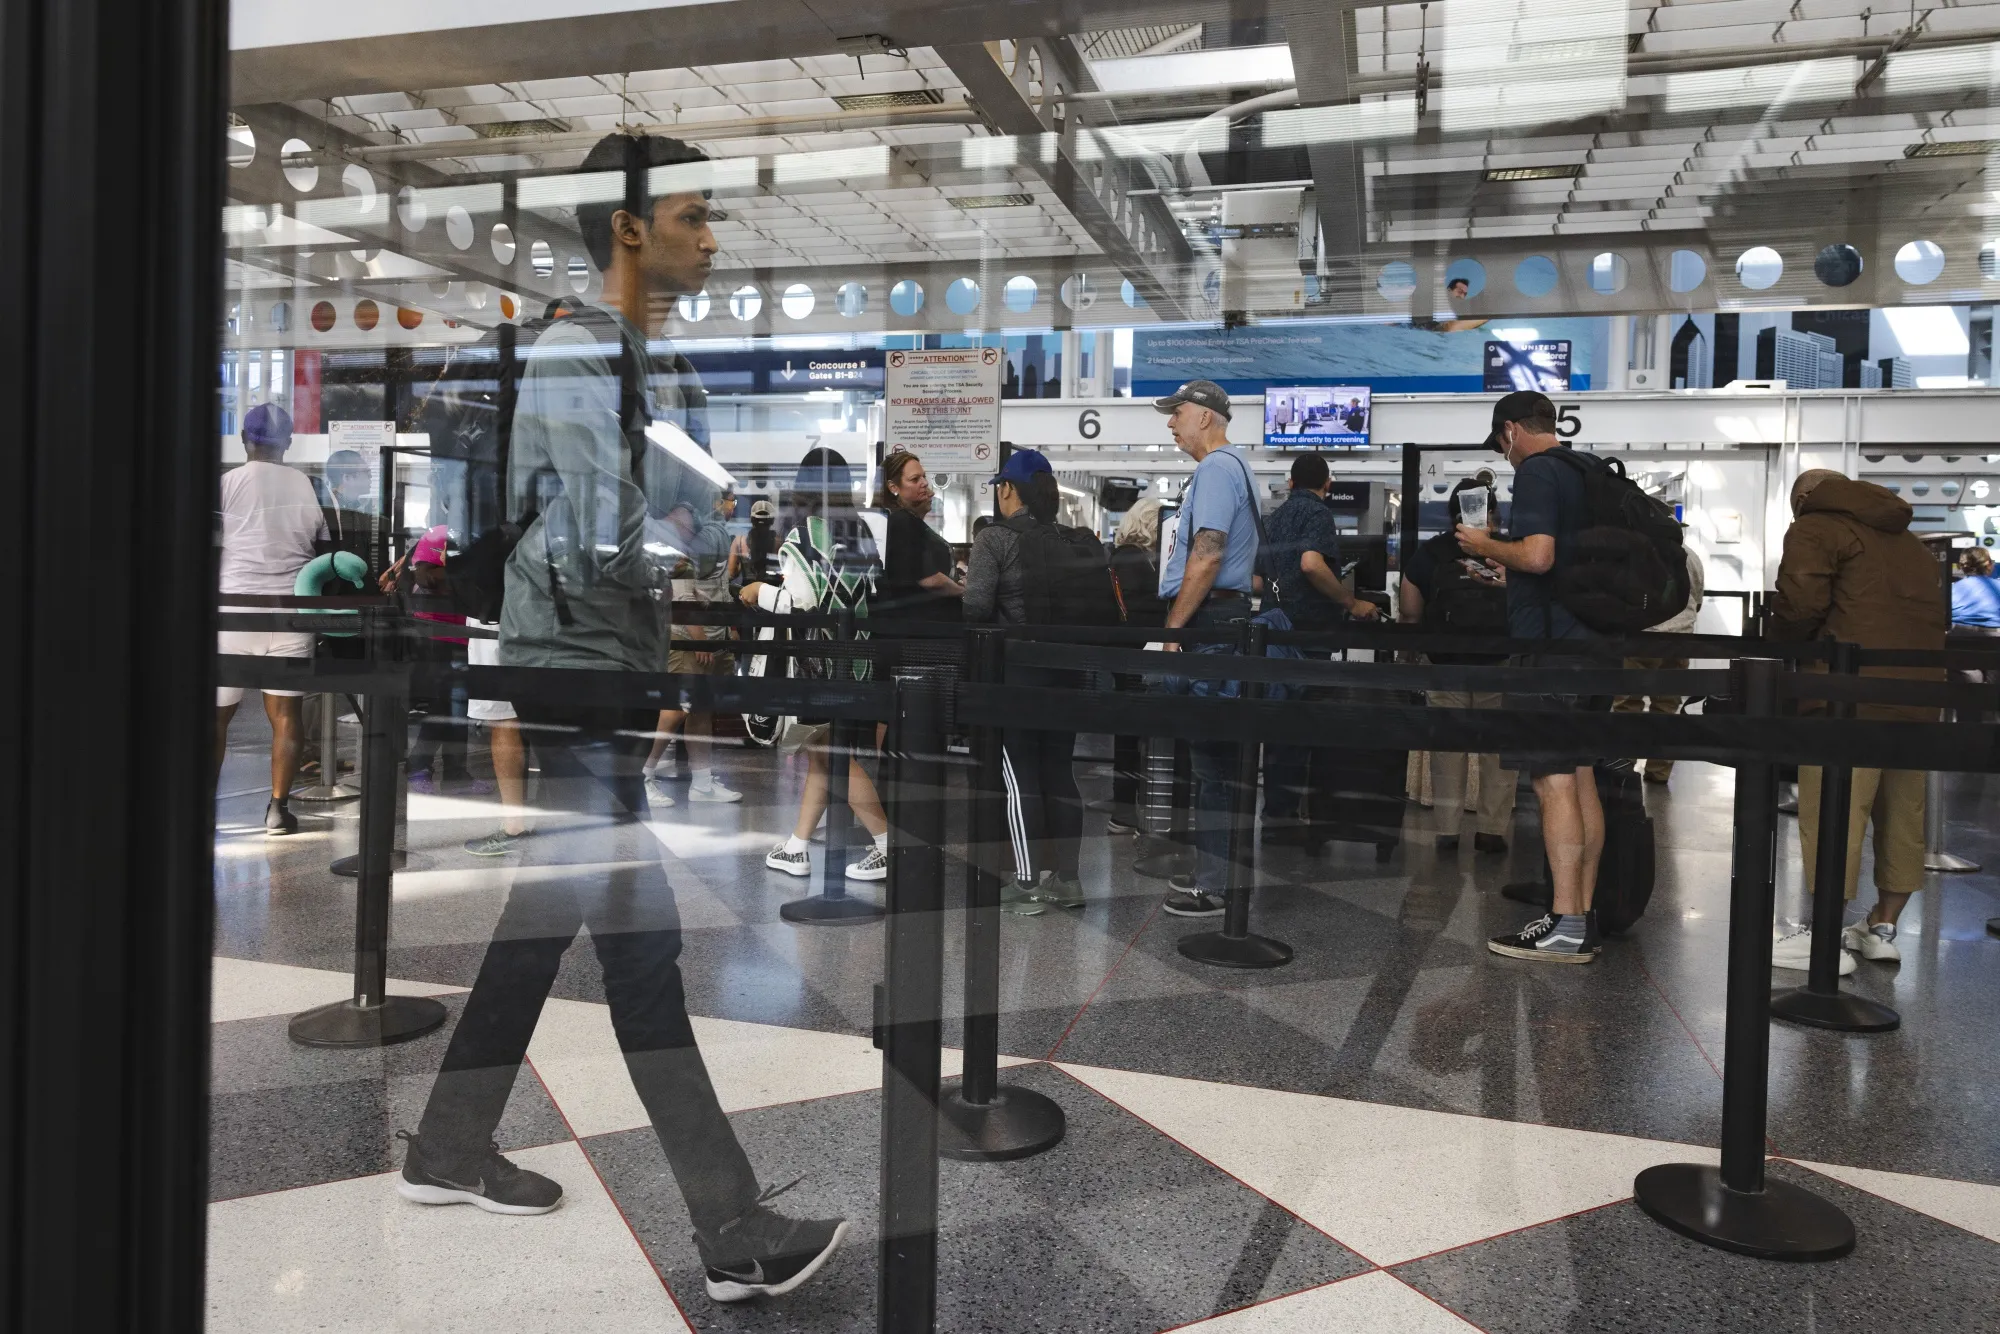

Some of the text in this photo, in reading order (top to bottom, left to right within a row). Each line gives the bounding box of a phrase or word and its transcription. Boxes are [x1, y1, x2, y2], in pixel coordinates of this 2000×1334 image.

[1208, 338, 1226, 346] Entry
[809, 360, 866, 370] Concourse B
[809, 371, 833, 380] Gates
[1078, 409, 1101, 439] 6
[1556, 405, 1582, 437] 5
[805, 435, 821, 453] 7
[1298, 436, 1323, 444] directly
[1333, 436, 1365, 444] screening
[1427, 464, 1436, 476] 4
[980, 482, 987, 494] 5
